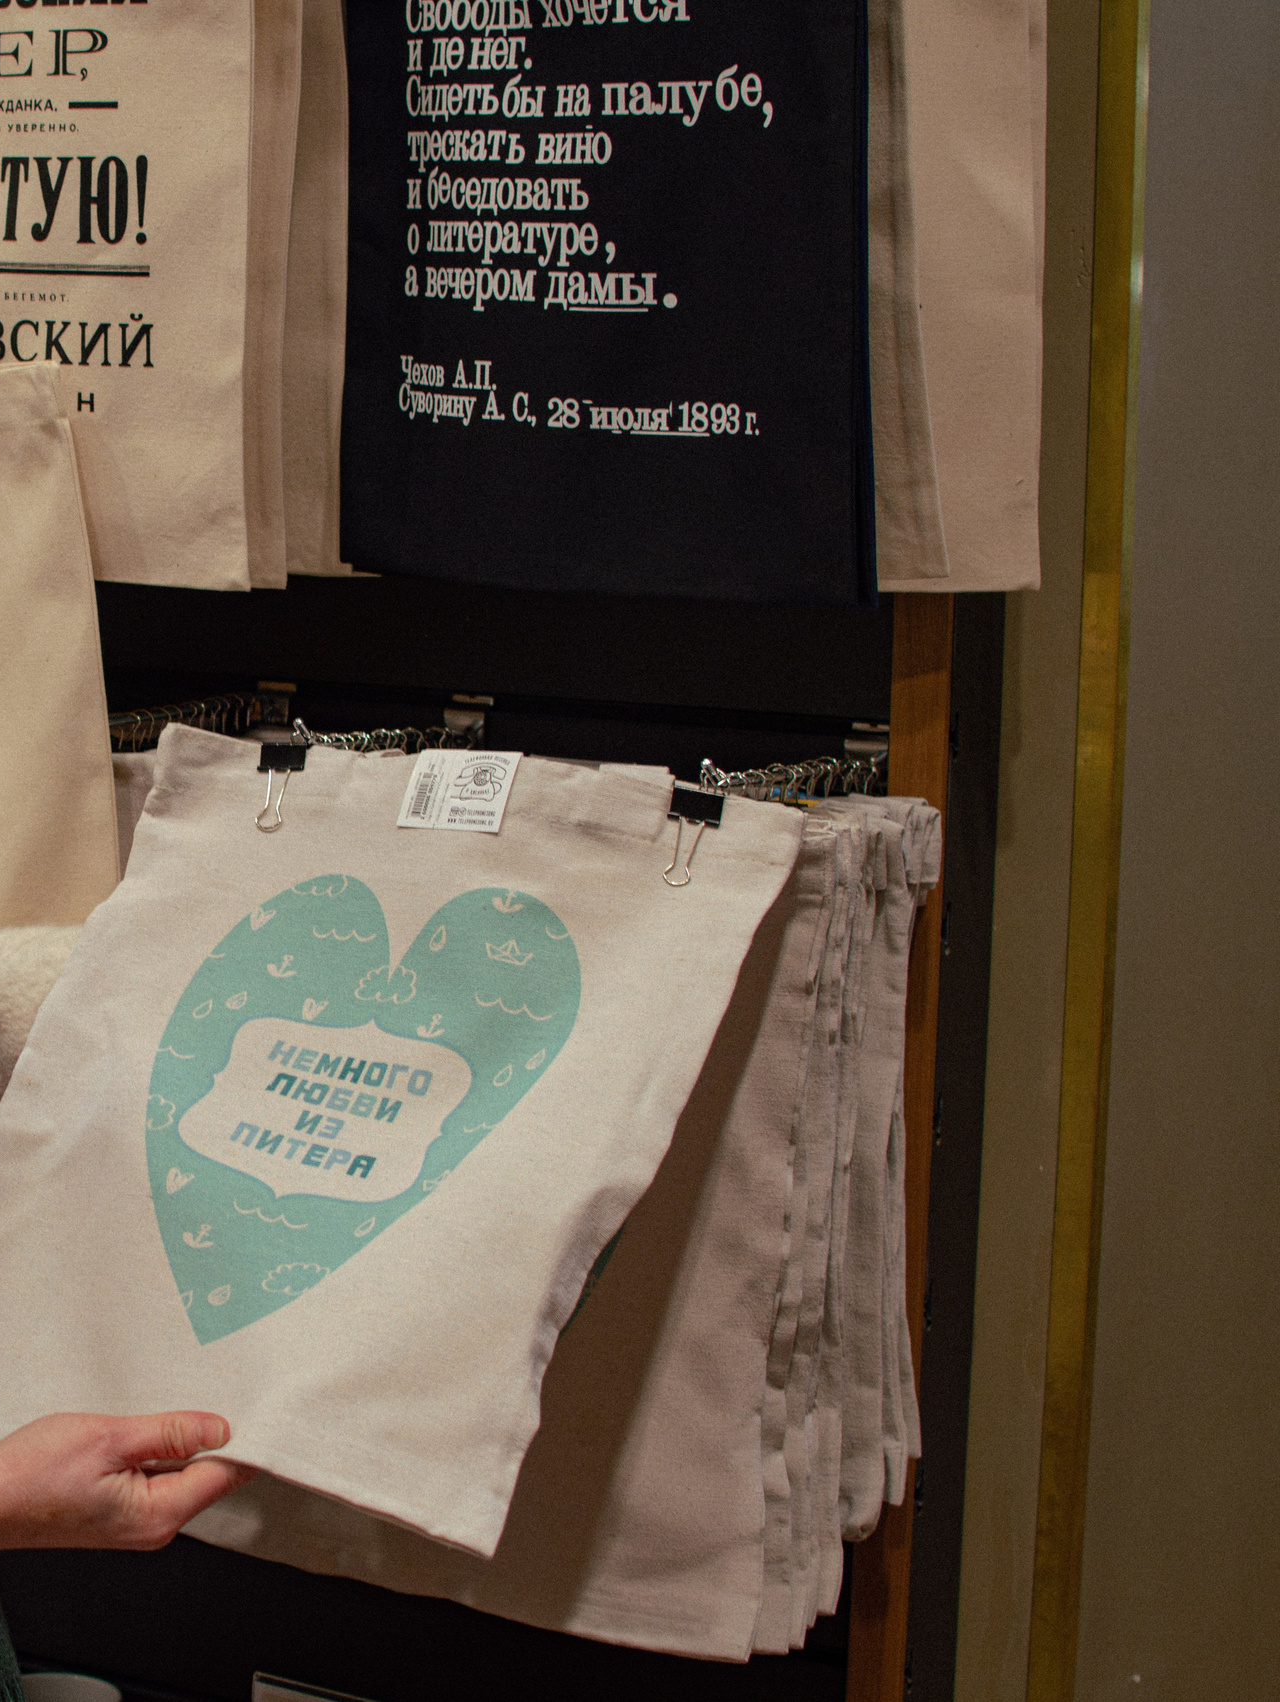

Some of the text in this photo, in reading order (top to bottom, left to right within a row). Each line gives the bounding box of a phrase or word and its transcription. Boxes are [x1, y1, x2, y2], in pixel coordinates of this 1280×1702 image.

[541, 0, 691, 28] хочется
[407, 38, 423, 72] и
[406, 74, 500, 122] Сидеть
[501, 73, 545, 118] бы
[554, 83, 592, 118] на
[7, 123, 80, 133] УВЕРЕННО.
[407, 125, 613, 172] трескать вино
[406, 166, 589, 216] и беседовать
[407, 220, 616, 267] о литературе,
[405, 265, 678, 312] а вечером дамы.
[401, 355, 445, 389] Чехов
[399, 383, 477, 426] Суворину
[547, 397, 580, 428] 28
[677, 401, 740, 434] 1893
[745, 411, 760, 436] г.
[268, 1039, 434, 1097] НЕМНОГО
[266, 1072, 404, 1124] ЛЮБВИ
[294, 1109, 346, 1140] ИЗ
[229, 1121, 377, 1179] ПИТЕРА
